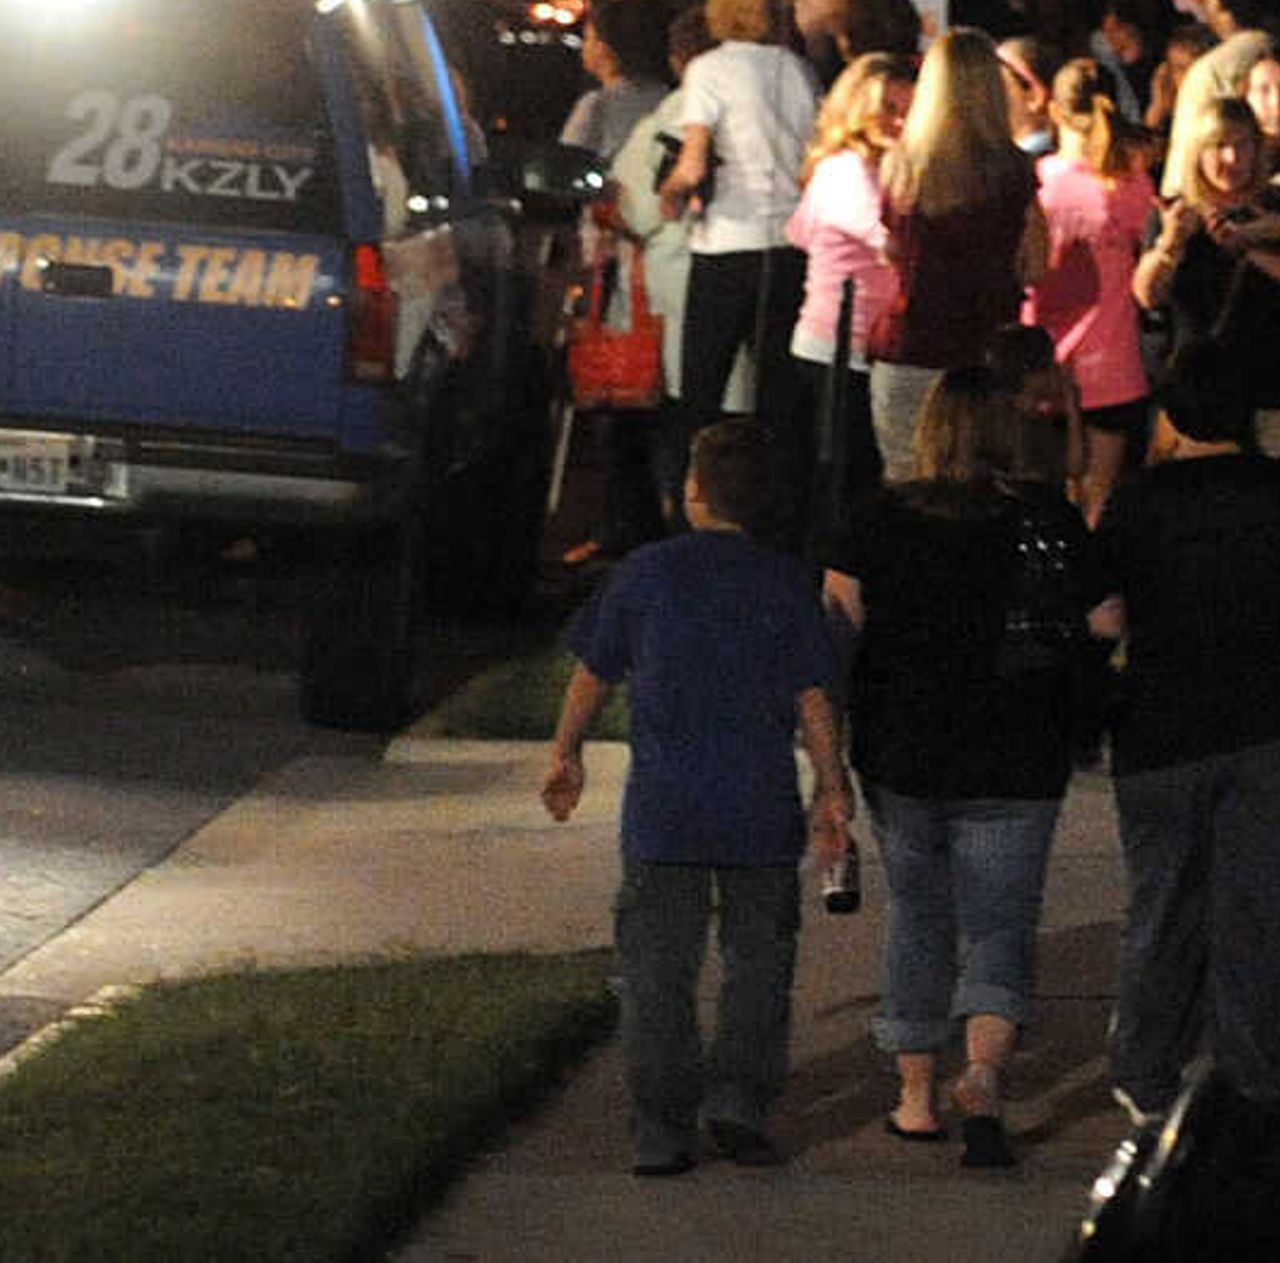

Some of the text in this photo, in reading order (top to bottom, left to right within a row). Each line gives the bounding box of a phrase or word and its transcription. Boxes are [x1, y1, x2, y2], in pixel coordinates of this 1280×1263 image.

[47, 90, 167, 188] 28
[160, 158, 314, 200] KZLY
[173, 242, 320, 310] TEAM
